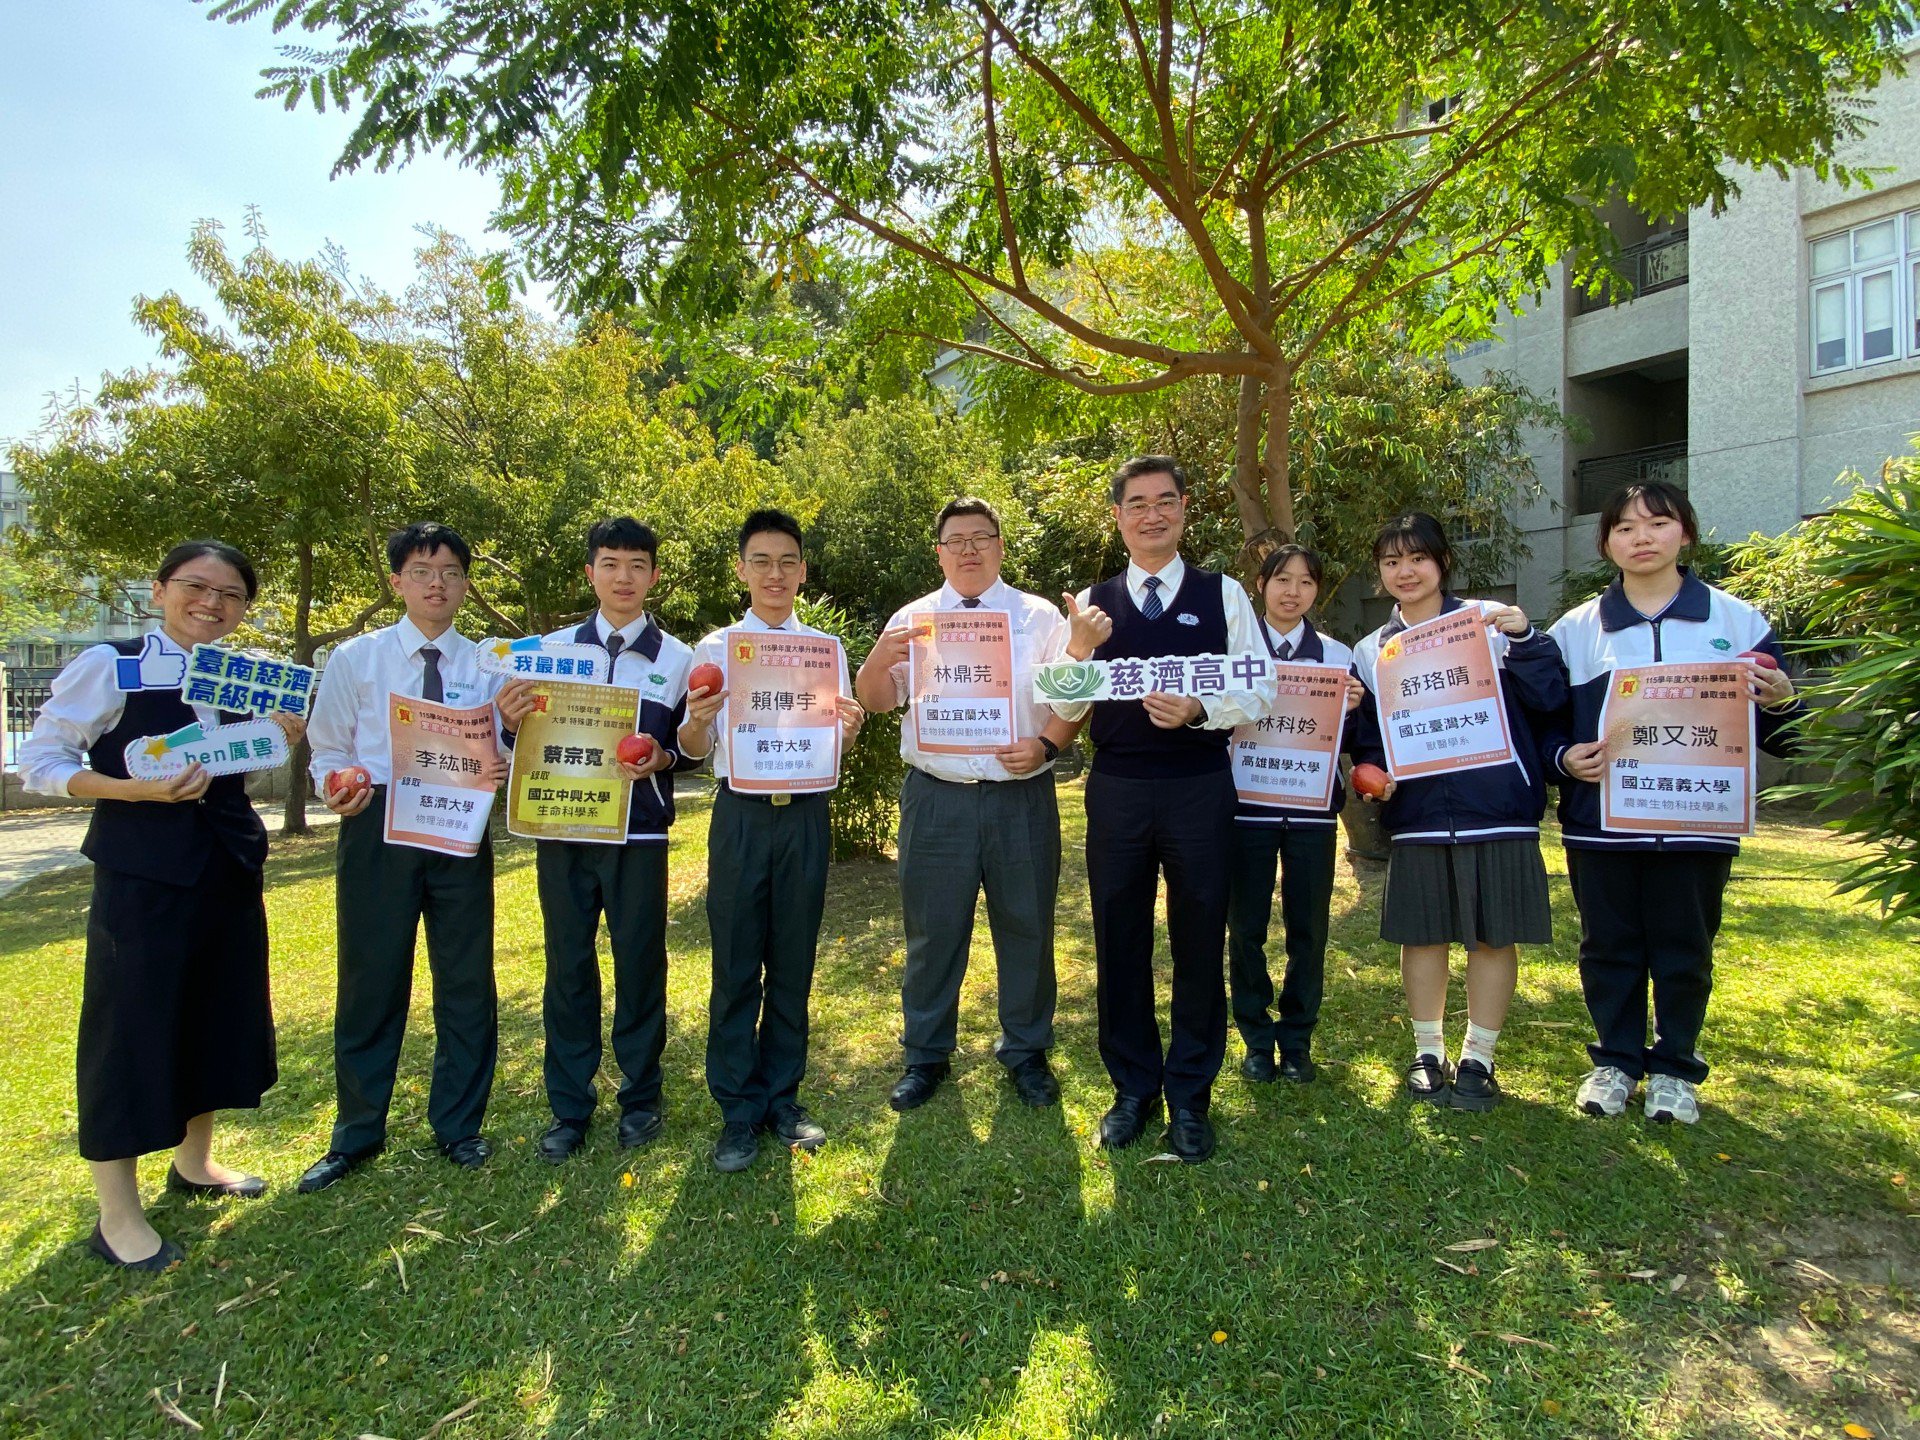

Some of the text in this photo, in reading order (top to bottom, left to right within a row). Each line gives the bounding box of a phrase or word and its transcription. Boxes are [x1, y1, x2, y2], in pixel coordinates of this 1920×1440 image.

[739, 646, 751, 659] 賀
[193, 648, 312, 693] 臺南慈濟
[514, 655, 594, 676] 我最耀眼
[934, 665, 992, 683] 林鼎芫
[1109, 654, 1266, 695] 慈濟高中
[1400, 666, 1470, 697] 舒珞晴
[1646, 674, 1737, 683] 115學年度大學升學榜單
[1621, 680, 1635, 693] 賀
[187, 677, 307, 716] 高級中學
[751, 691, 817, 711] 賴傳宇
[922, 694, 939, 703] 錄取
[1701, 690, 1736, 699] 錄取金榜
[552, 716, 567, 725] 大學
[569, 717, 601, 727] 特殊選才
[926, 708, 1001, 721] 國立宜蘭大學
[1392, 709, 1411, 720] 錄取
[737, 723, 757, 733] 錄取
[920, 727, 1010, 737] 生物技術與動物科學系
[1255, 715, 1317, 735] 林科妗
[1398, 711, 1489, 738] 國立臺灣大學
[756, 739, 812, 753] 義守大學
[1239, 741, 1257, 750] 錄取
[1426, 736, 1470, 751] 獸醫學系
[1632, 725, 1743, 754] 鄭又溦 同學
[415, 749, 483, 775] 李紘曄
[543, 745, 604, 766] 蔡宗寬
[753, 760, 815, 770] 物理治療學系
[1241, 755, 1320, 773] 高雄醫學大學
[1616, 758, 1639, 769] 錄取
[401, 776, 422, 787] 錄取
[530, 771, 550, 780] 錄取
[1621, 775, 1731, 794] 國立嘉義大學
[527, 787, 611, 804] 國立中興大學
[419, 794, 475, 813] 慈濟大學
[537, 805, 599, 817] 生命科學系
[1623, 797, 1729, 812] 農業生物科技學系
[415, 814, 469, 831] 物理治療學系
